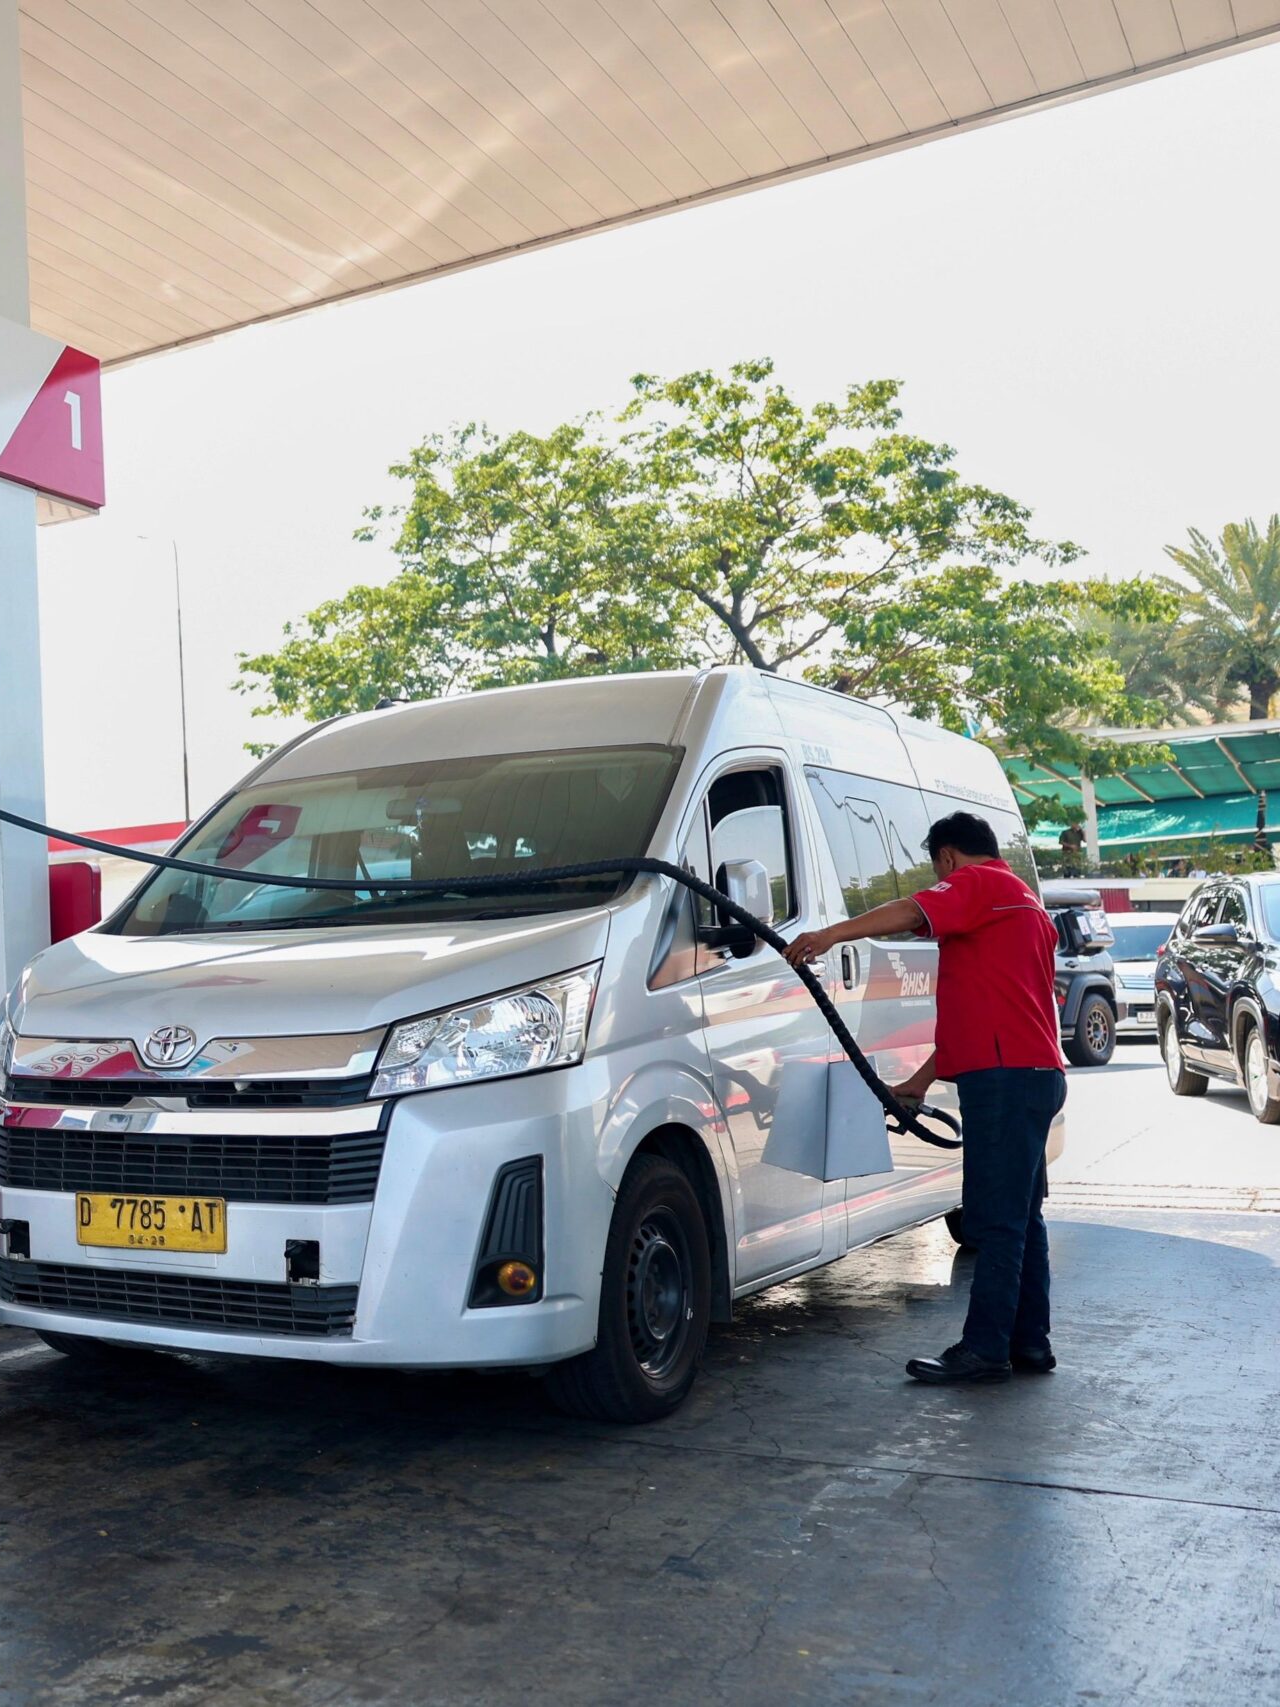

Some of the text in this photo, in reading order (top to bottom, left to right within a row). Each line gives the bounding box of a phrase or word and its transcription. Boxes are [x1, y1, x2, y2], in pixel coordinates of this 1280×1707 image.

[63, 390, 83, 452] 1
[900, 971, 930, 996] BHISA
[80, 1197, 218, 1234] D 7785 AT
